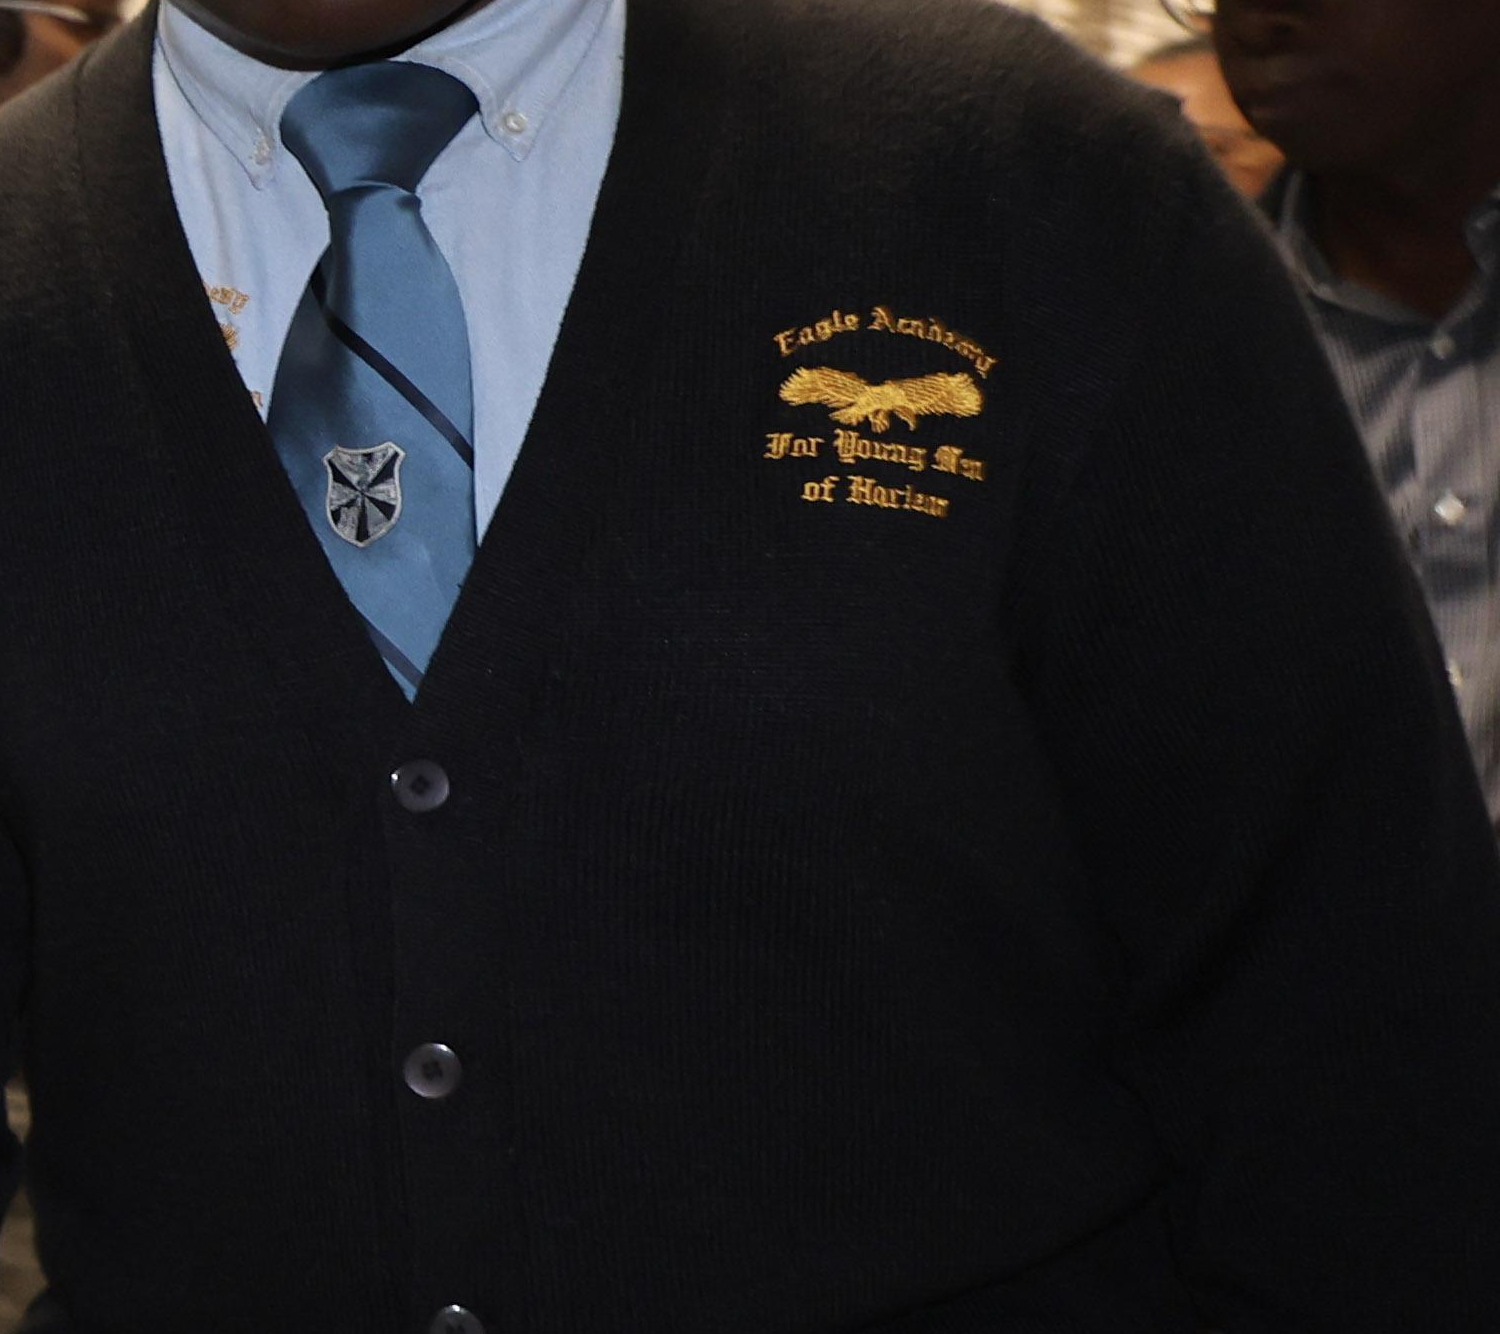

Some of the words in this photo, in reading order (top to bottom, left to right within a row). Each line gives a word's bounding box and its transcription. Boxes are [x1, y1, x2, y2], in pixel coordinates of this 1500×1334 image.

[763, 431, 826, 459] For
[832, 427, 928, 472] Young
[800, 476, 840, 503] of
